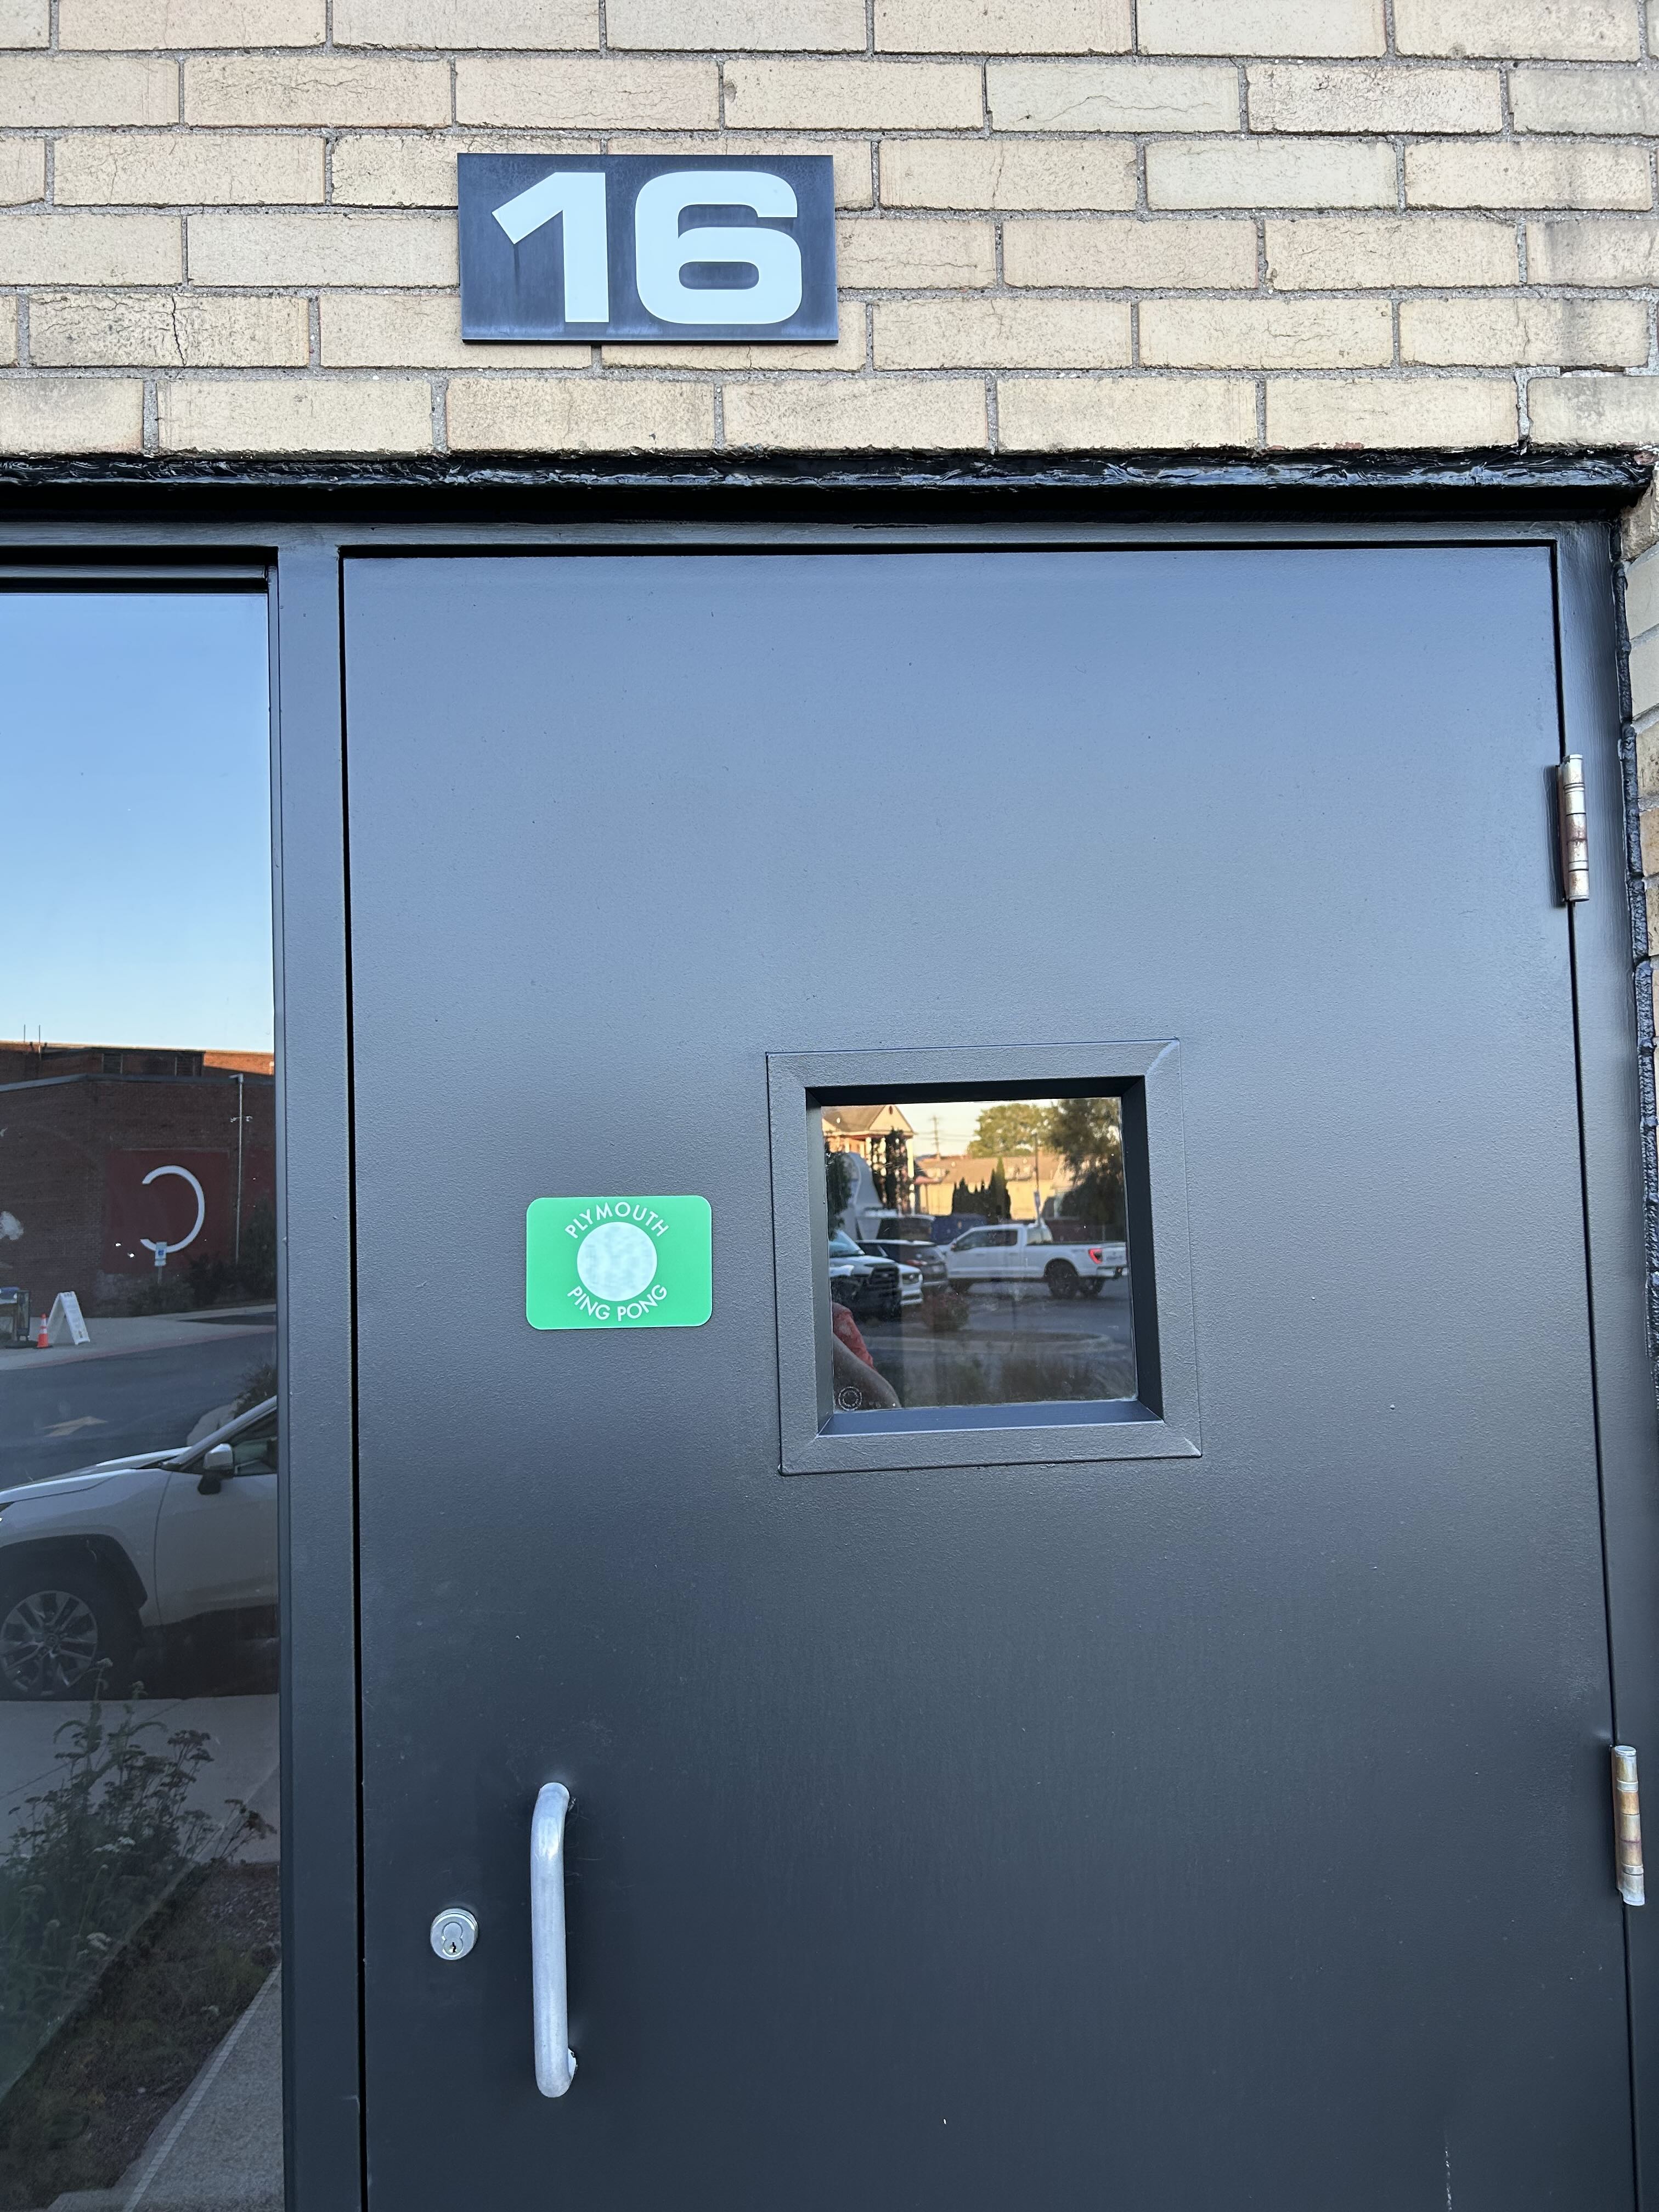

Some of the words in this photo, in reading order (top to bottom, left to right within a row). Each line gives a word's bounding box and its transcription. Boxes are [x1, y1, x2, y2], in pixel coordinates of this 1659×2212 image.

[492, 171, 803, 325] 16
[565, 1201, 669, 1239] PLYMOUTH
[567, 1285, 611, 1320] PING
[617, 1284, 667, 1322] PONG
